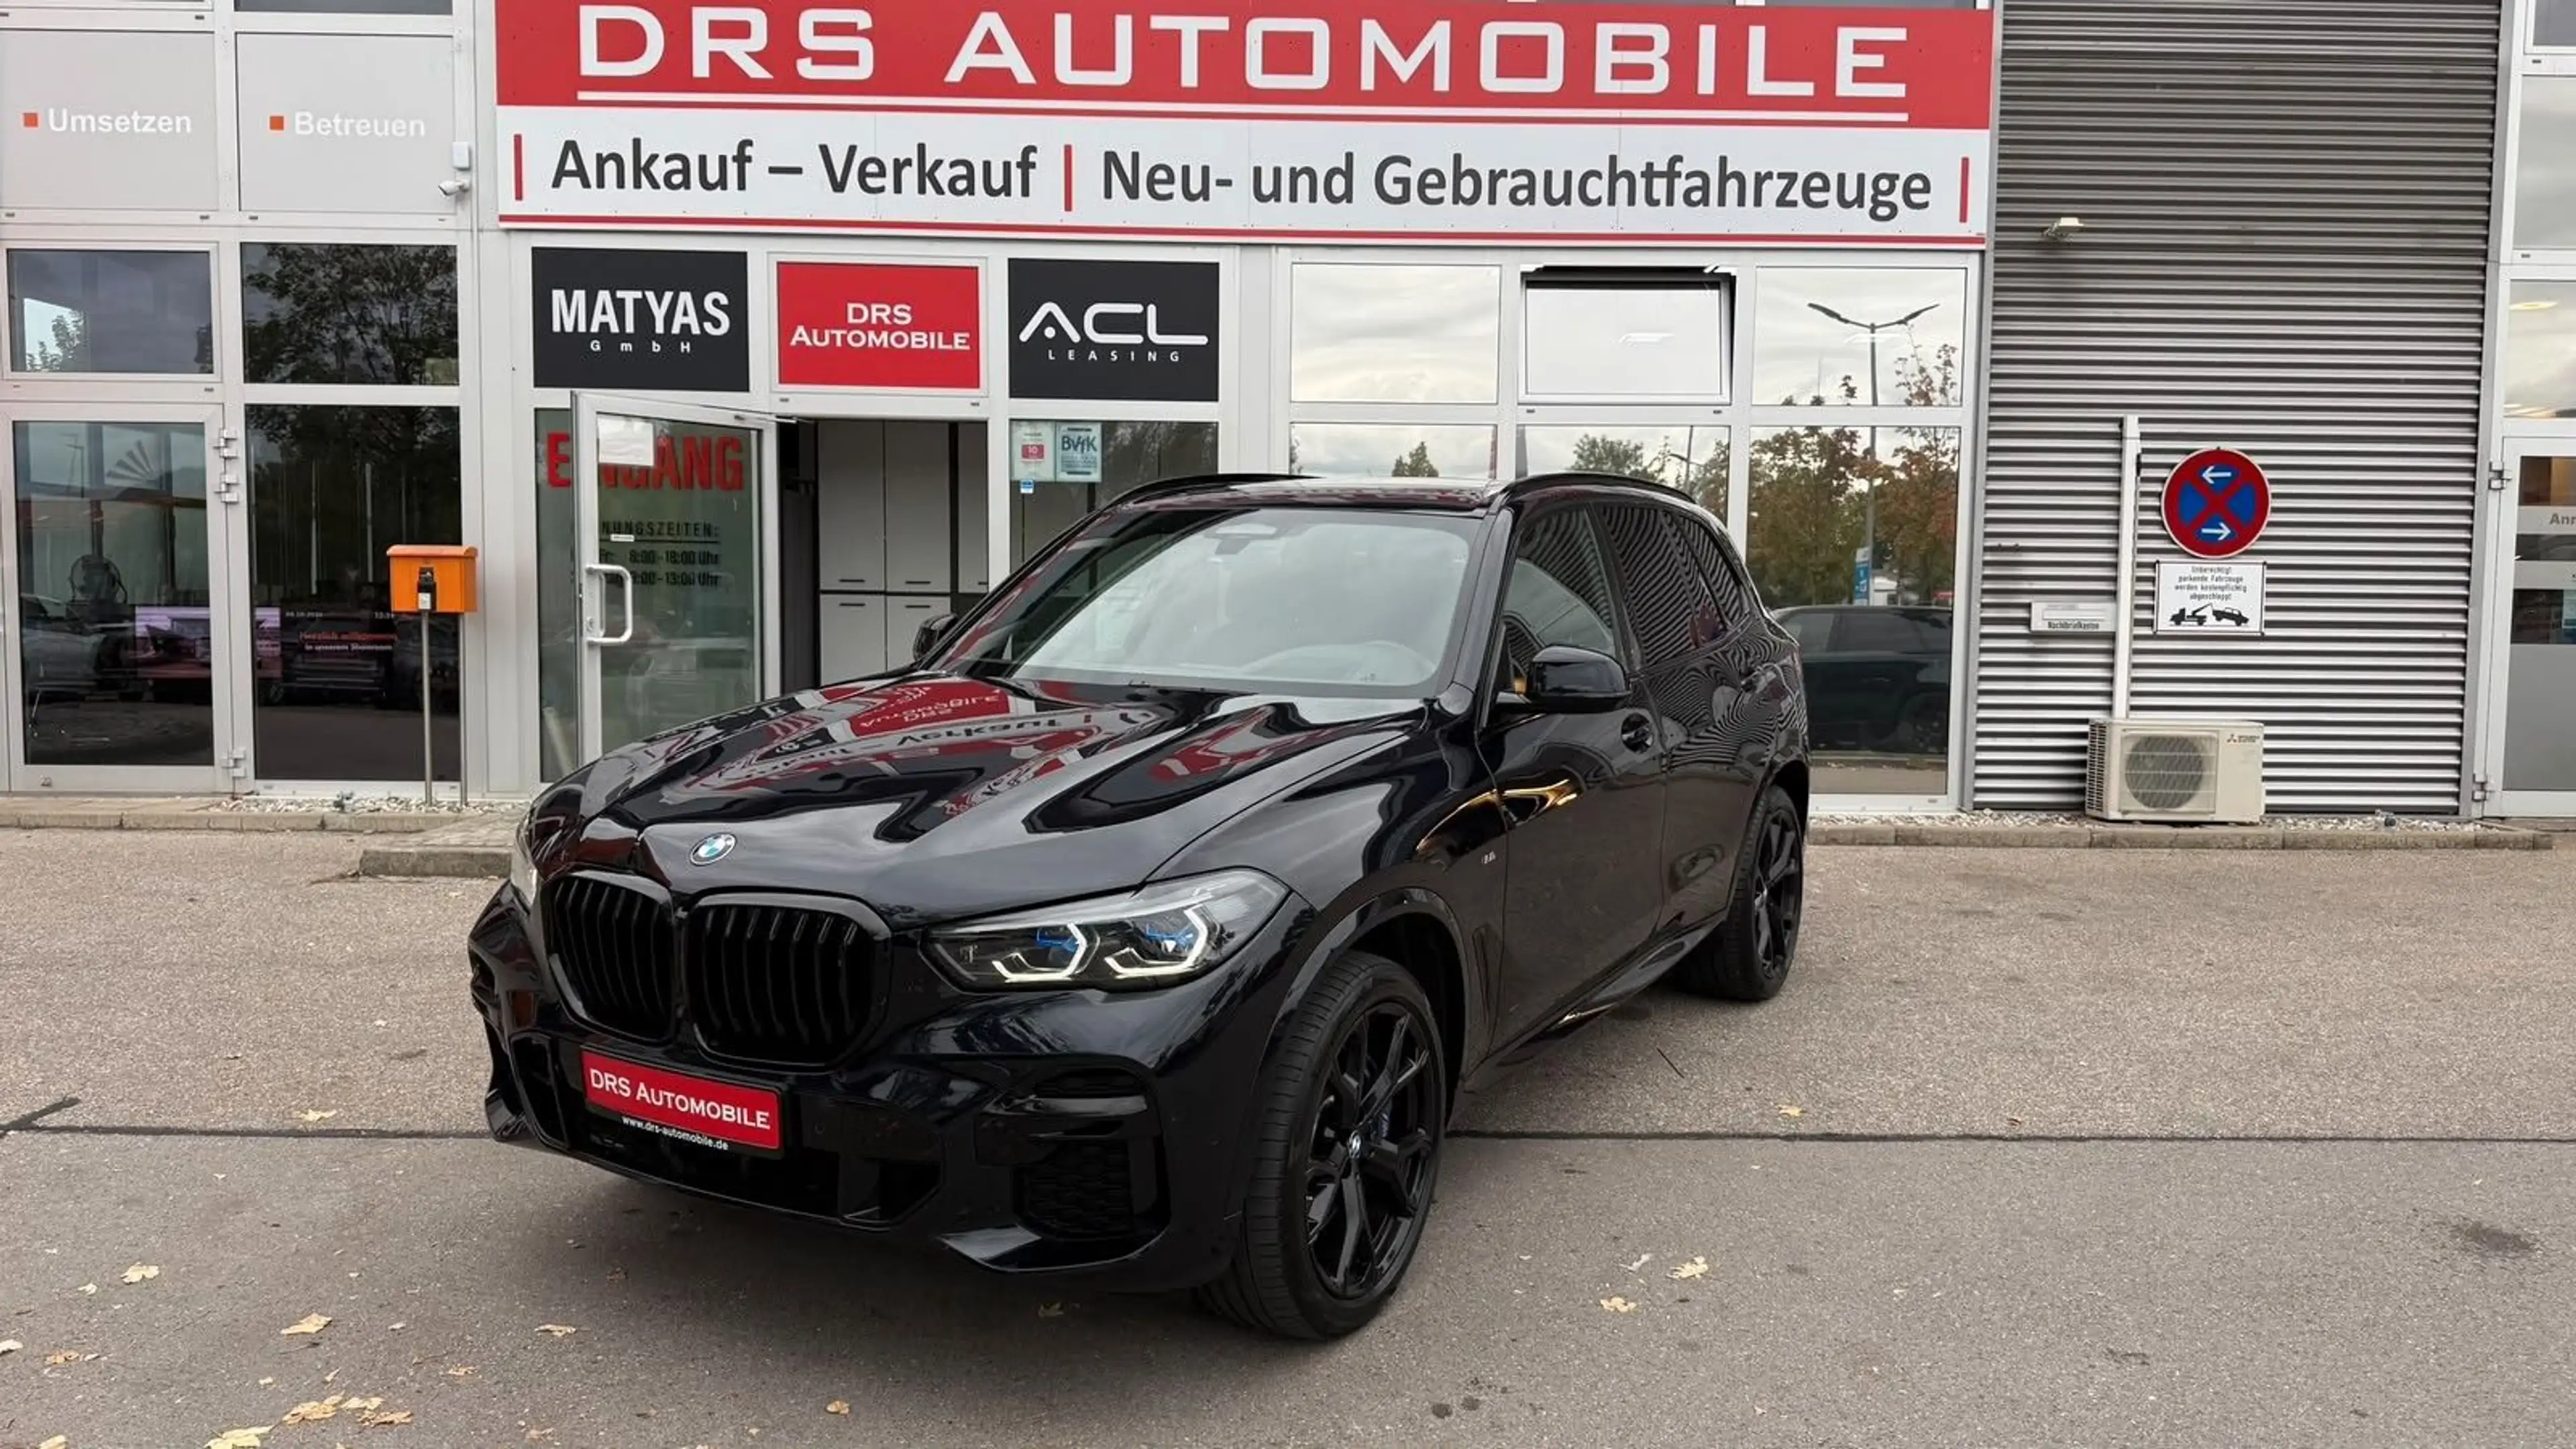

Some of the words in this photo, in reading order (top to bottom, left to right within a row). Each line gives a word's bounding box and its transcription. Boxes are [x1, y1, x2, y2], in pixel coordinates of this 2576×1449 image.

[579, 5, 874, 80] DRS
[943, 11, 1908, 97] AUTOMOBILE
[48, 108, 192, 134] Umsetzen
[294, 111, 425, 138] Betreuen
[551, 137, 754, 191] Ankauf
[818, 142, 1038, 197] Verkauf
[1103, 150, 1234, 202] Neu-
[1252, 152, 1354, 204] und
[1374, 153, 1932, 222] Gebrauchtfahrzeuge
[551, 288, 731, 336] MATYAS
[847, 302, 913, 325] DRS
[1018, 301, 1209, 346] ACL
[790, 324, 971, 350] AUTOMOBILE
[1048, 349, 1180, 362] LEASING
[547, 432, 745, 492] EANG
[589, 1067, 631, 1097] DRS
[635, 1081, 771, 1130] AUTOMOBILE
[621, 1116, 729, 1151] www.drs-automobile.de
